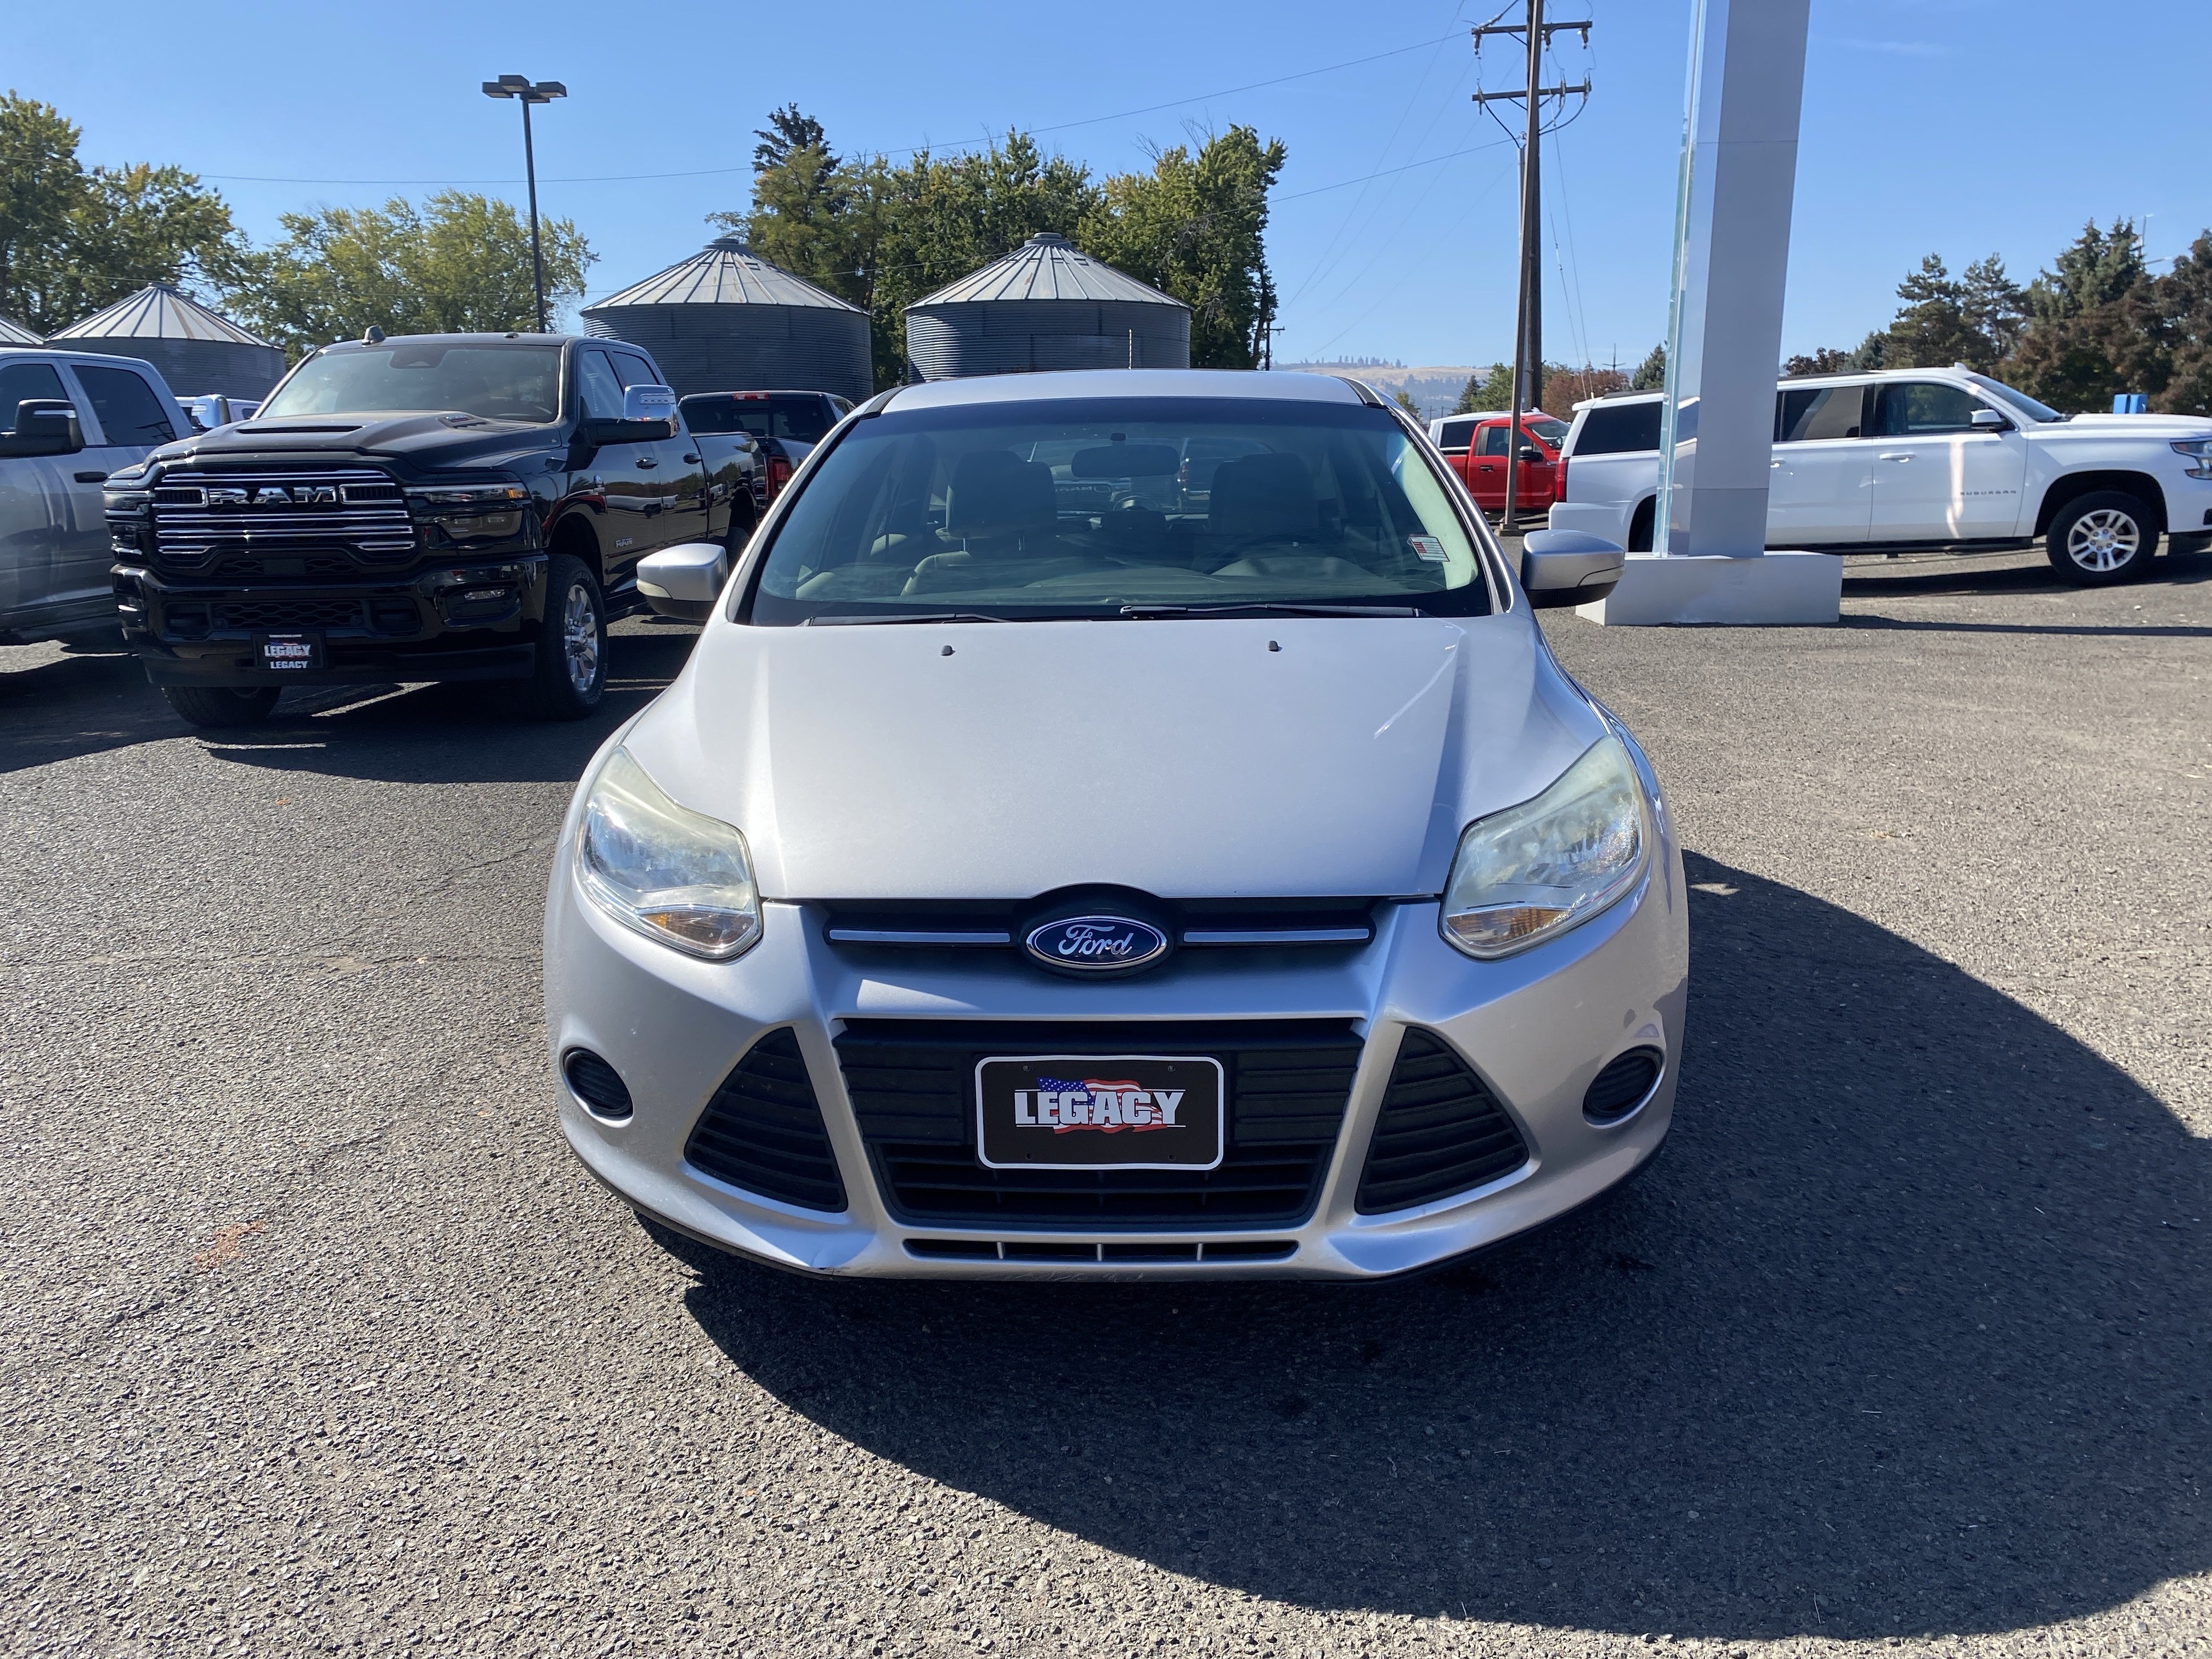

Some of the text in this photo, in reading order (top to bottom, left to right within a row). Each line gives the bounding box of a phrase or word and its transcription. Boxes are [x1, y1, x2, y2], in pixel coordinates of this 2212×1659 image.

[208, 487, 336, 504] RAM
[264, 645, 311, 656] LEGACY
[1058, 924, 1133, 955] Ford
[1014, 1091, 1184, 1124] LEGACY
